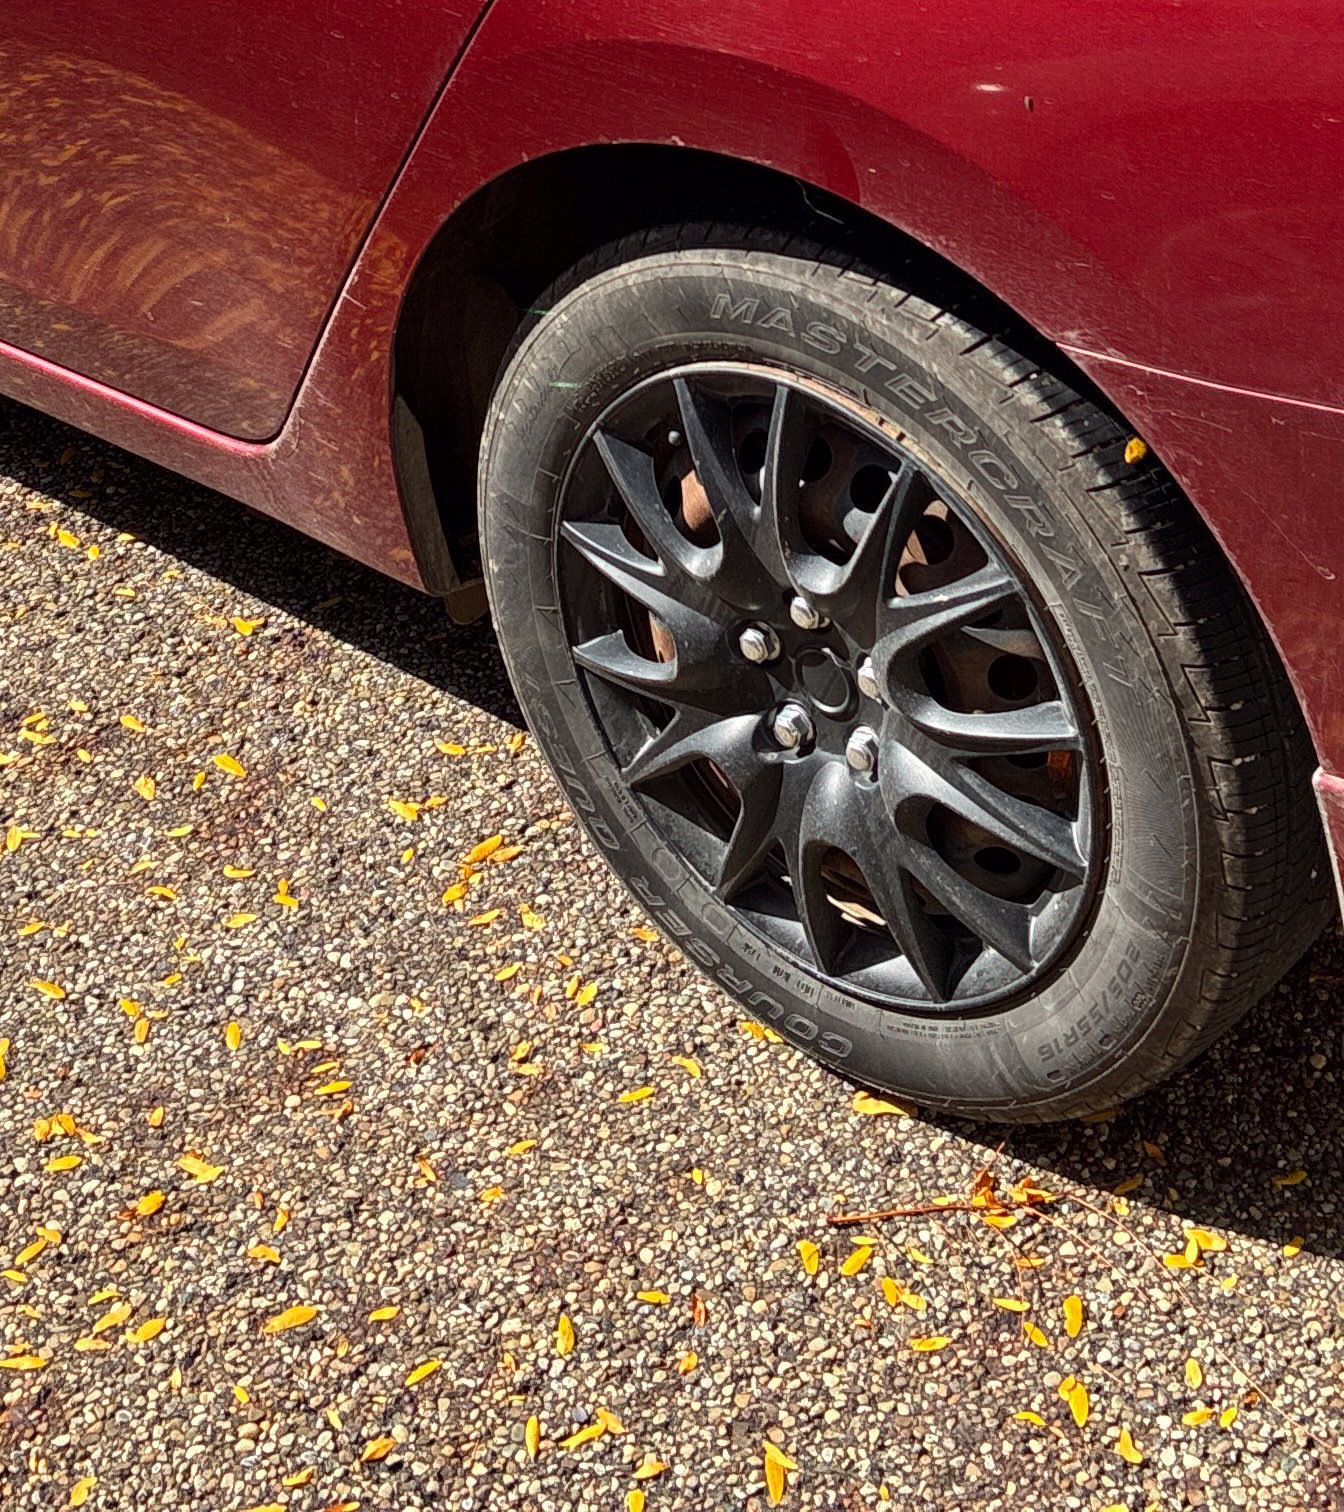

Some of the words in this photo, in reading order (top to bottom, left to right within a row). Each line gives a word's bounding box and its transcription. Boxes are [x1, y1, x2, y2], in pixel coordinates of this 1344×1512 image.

[709, 293, 1143, 707] MASTERCRAFT
[630, 875, 854, 1060] COURSER
[1036, 938, 1141, 1063] 205/55R16
